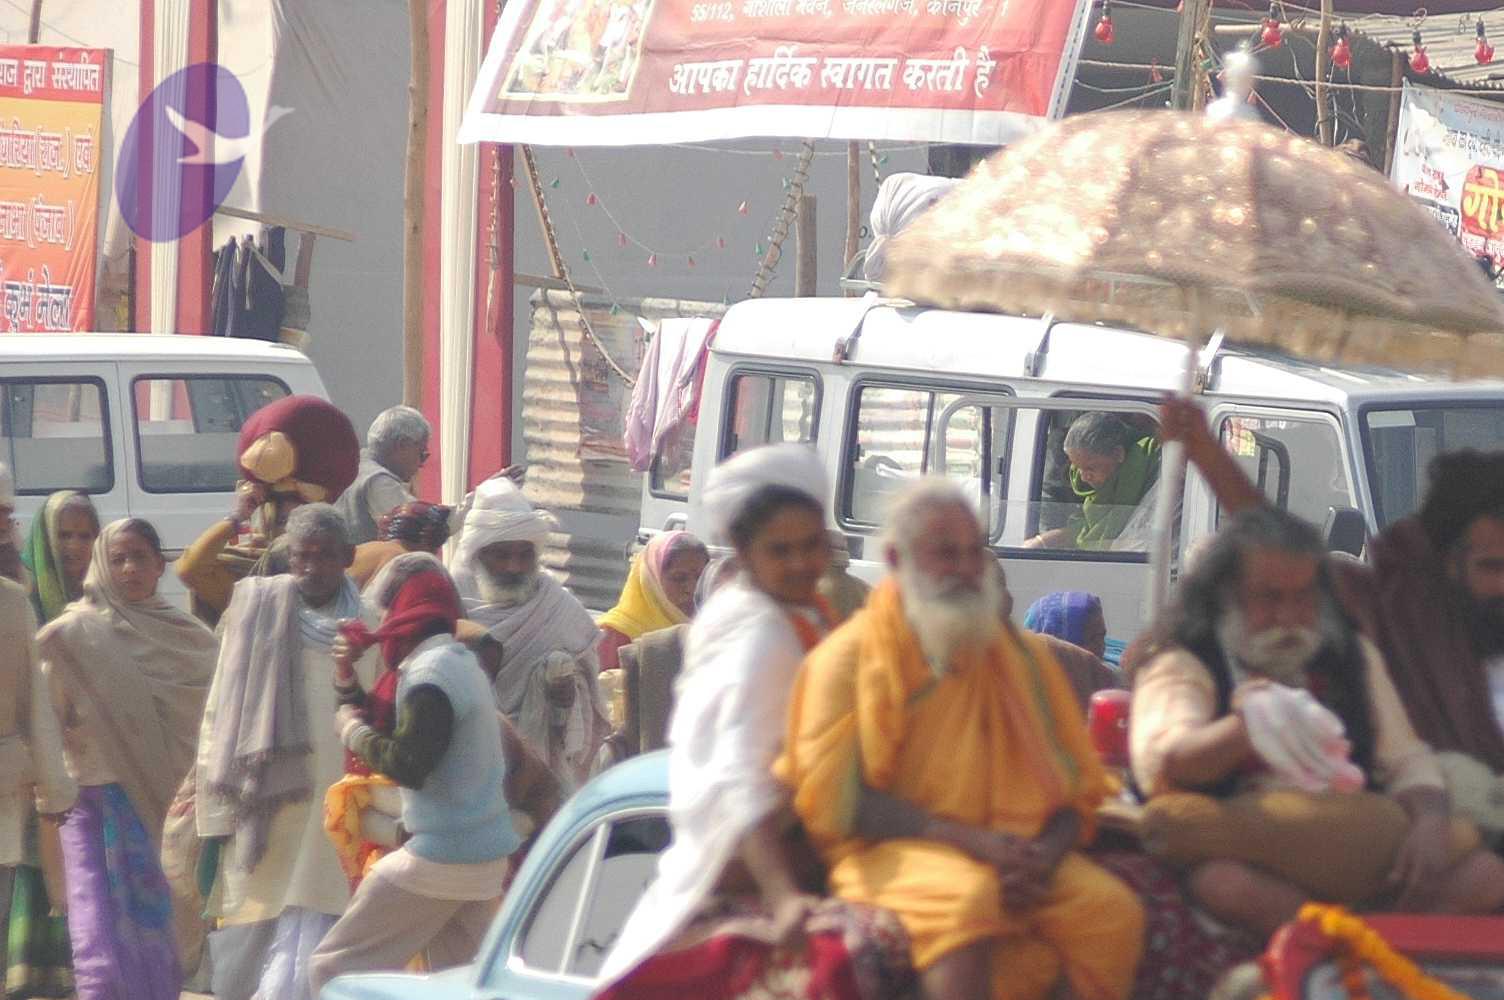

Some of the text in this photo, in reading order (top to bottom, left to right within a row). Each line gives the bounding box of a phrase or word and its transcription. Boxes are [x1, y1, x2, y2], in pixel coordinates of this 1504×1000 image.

[669, 45, 996, 98] आपका हार्दिक स्वागत करती है
